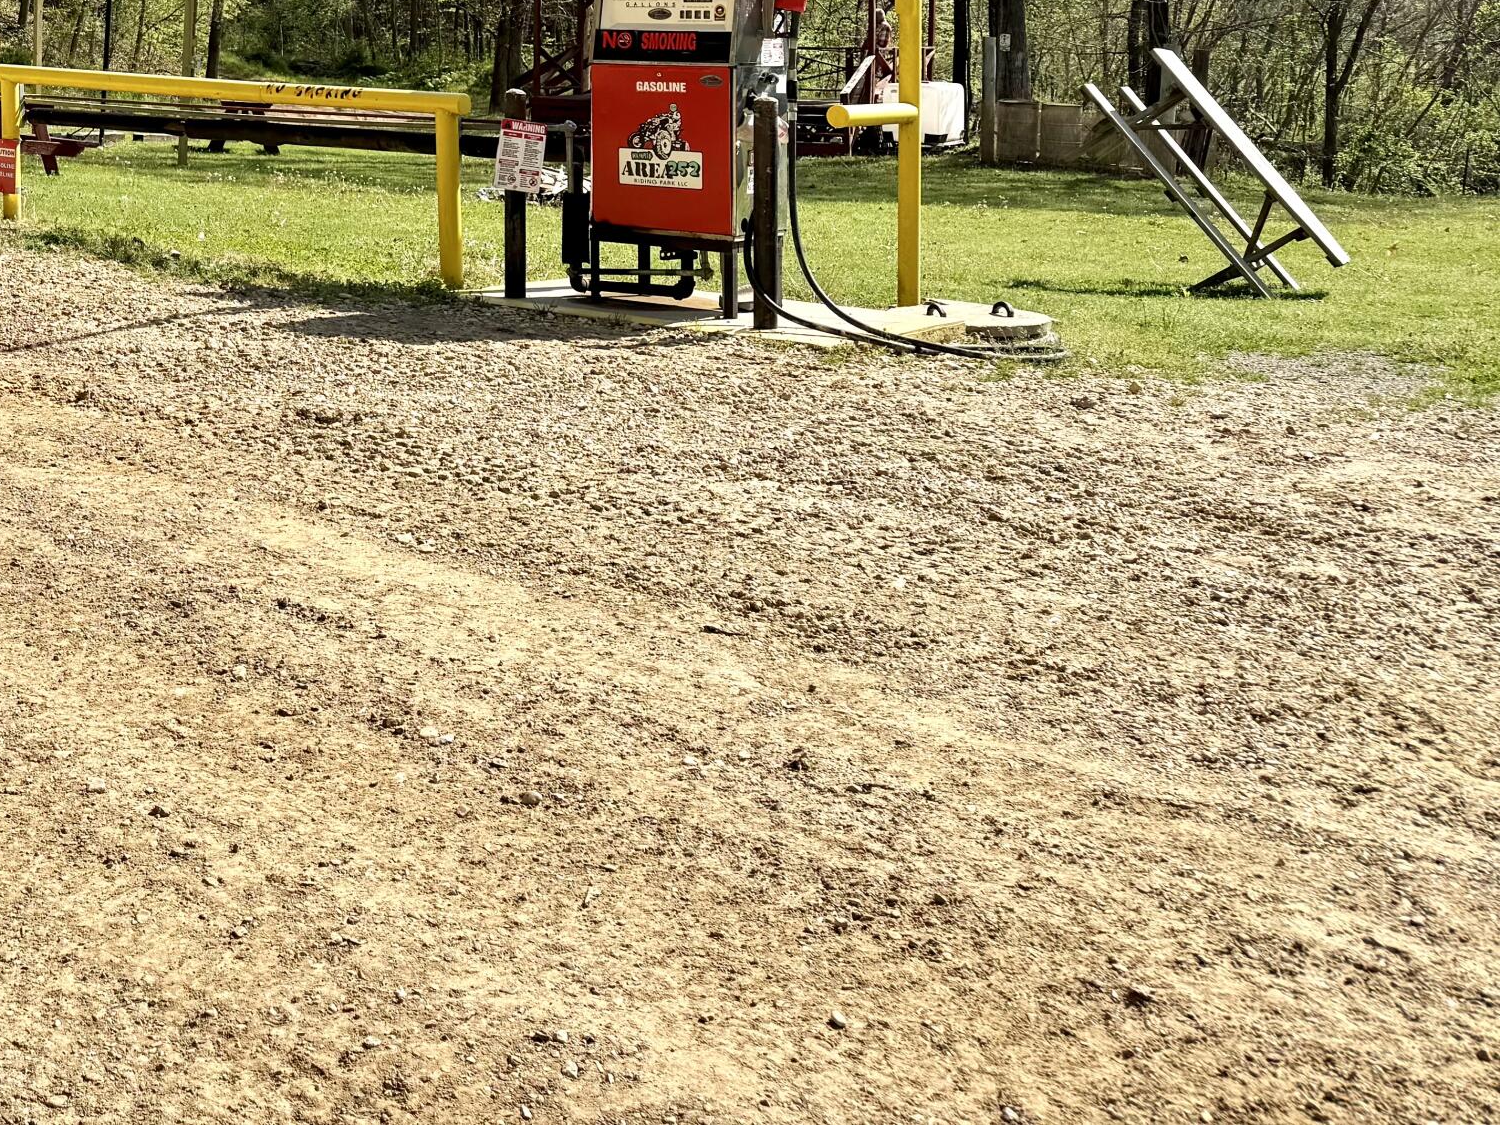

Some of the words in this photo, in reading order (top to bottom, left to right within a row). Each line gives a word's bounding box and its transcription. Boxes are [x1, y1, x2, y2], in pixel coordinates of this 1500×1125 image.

[641, 32, 697, 50] SMOKING
[266, 84, 285, 94] NO
[295, 86, 362, 99] SMOKING
[636, 81, 686, 93] GASOLINE
[512, 121, 545, 134] WARNING
[622, 161, 673, 179] AREA
[667, 161, 700, 177] 252
